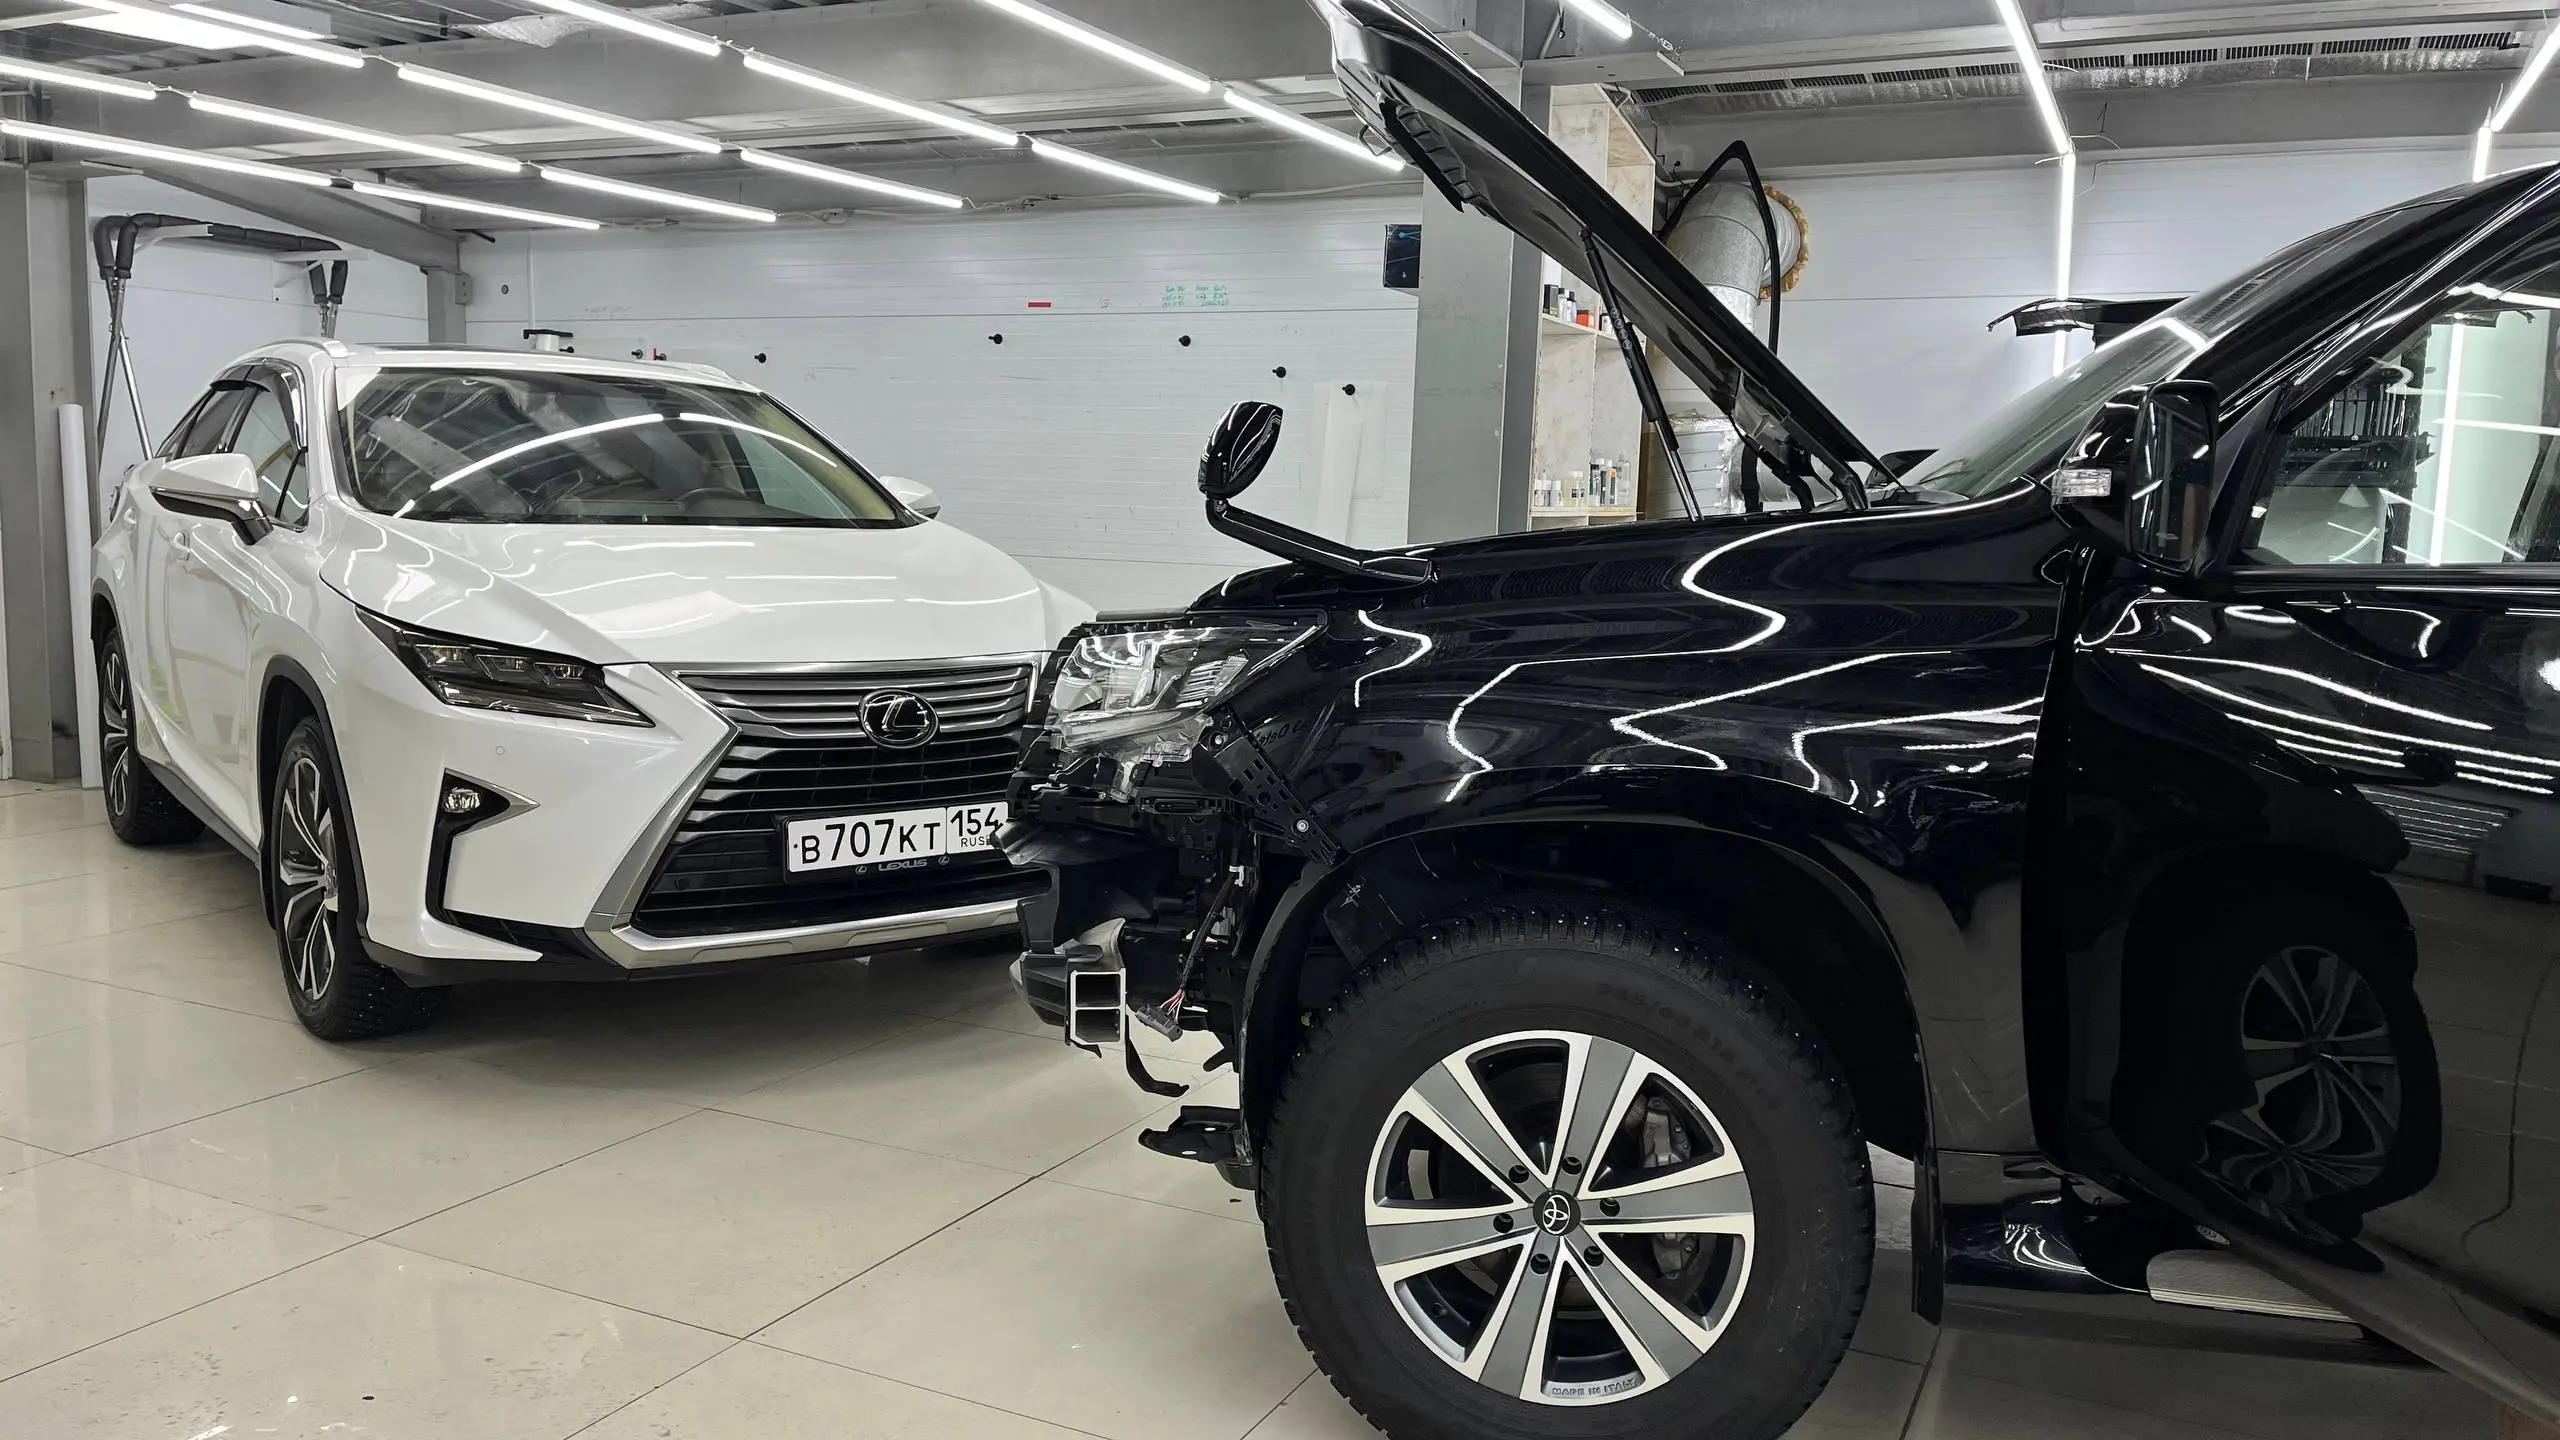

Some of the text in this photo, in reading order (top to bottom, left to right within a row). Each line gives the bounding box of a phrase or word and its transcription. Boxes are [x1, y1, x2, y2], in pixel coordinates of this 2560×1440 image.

[950, 807, 1004, 837] 154
[960, 837, 985, 848] RUS
[878, 858, 928, 872] LEXUS
[1552, 1377, 1634, 1396] MADE IN ITALY
